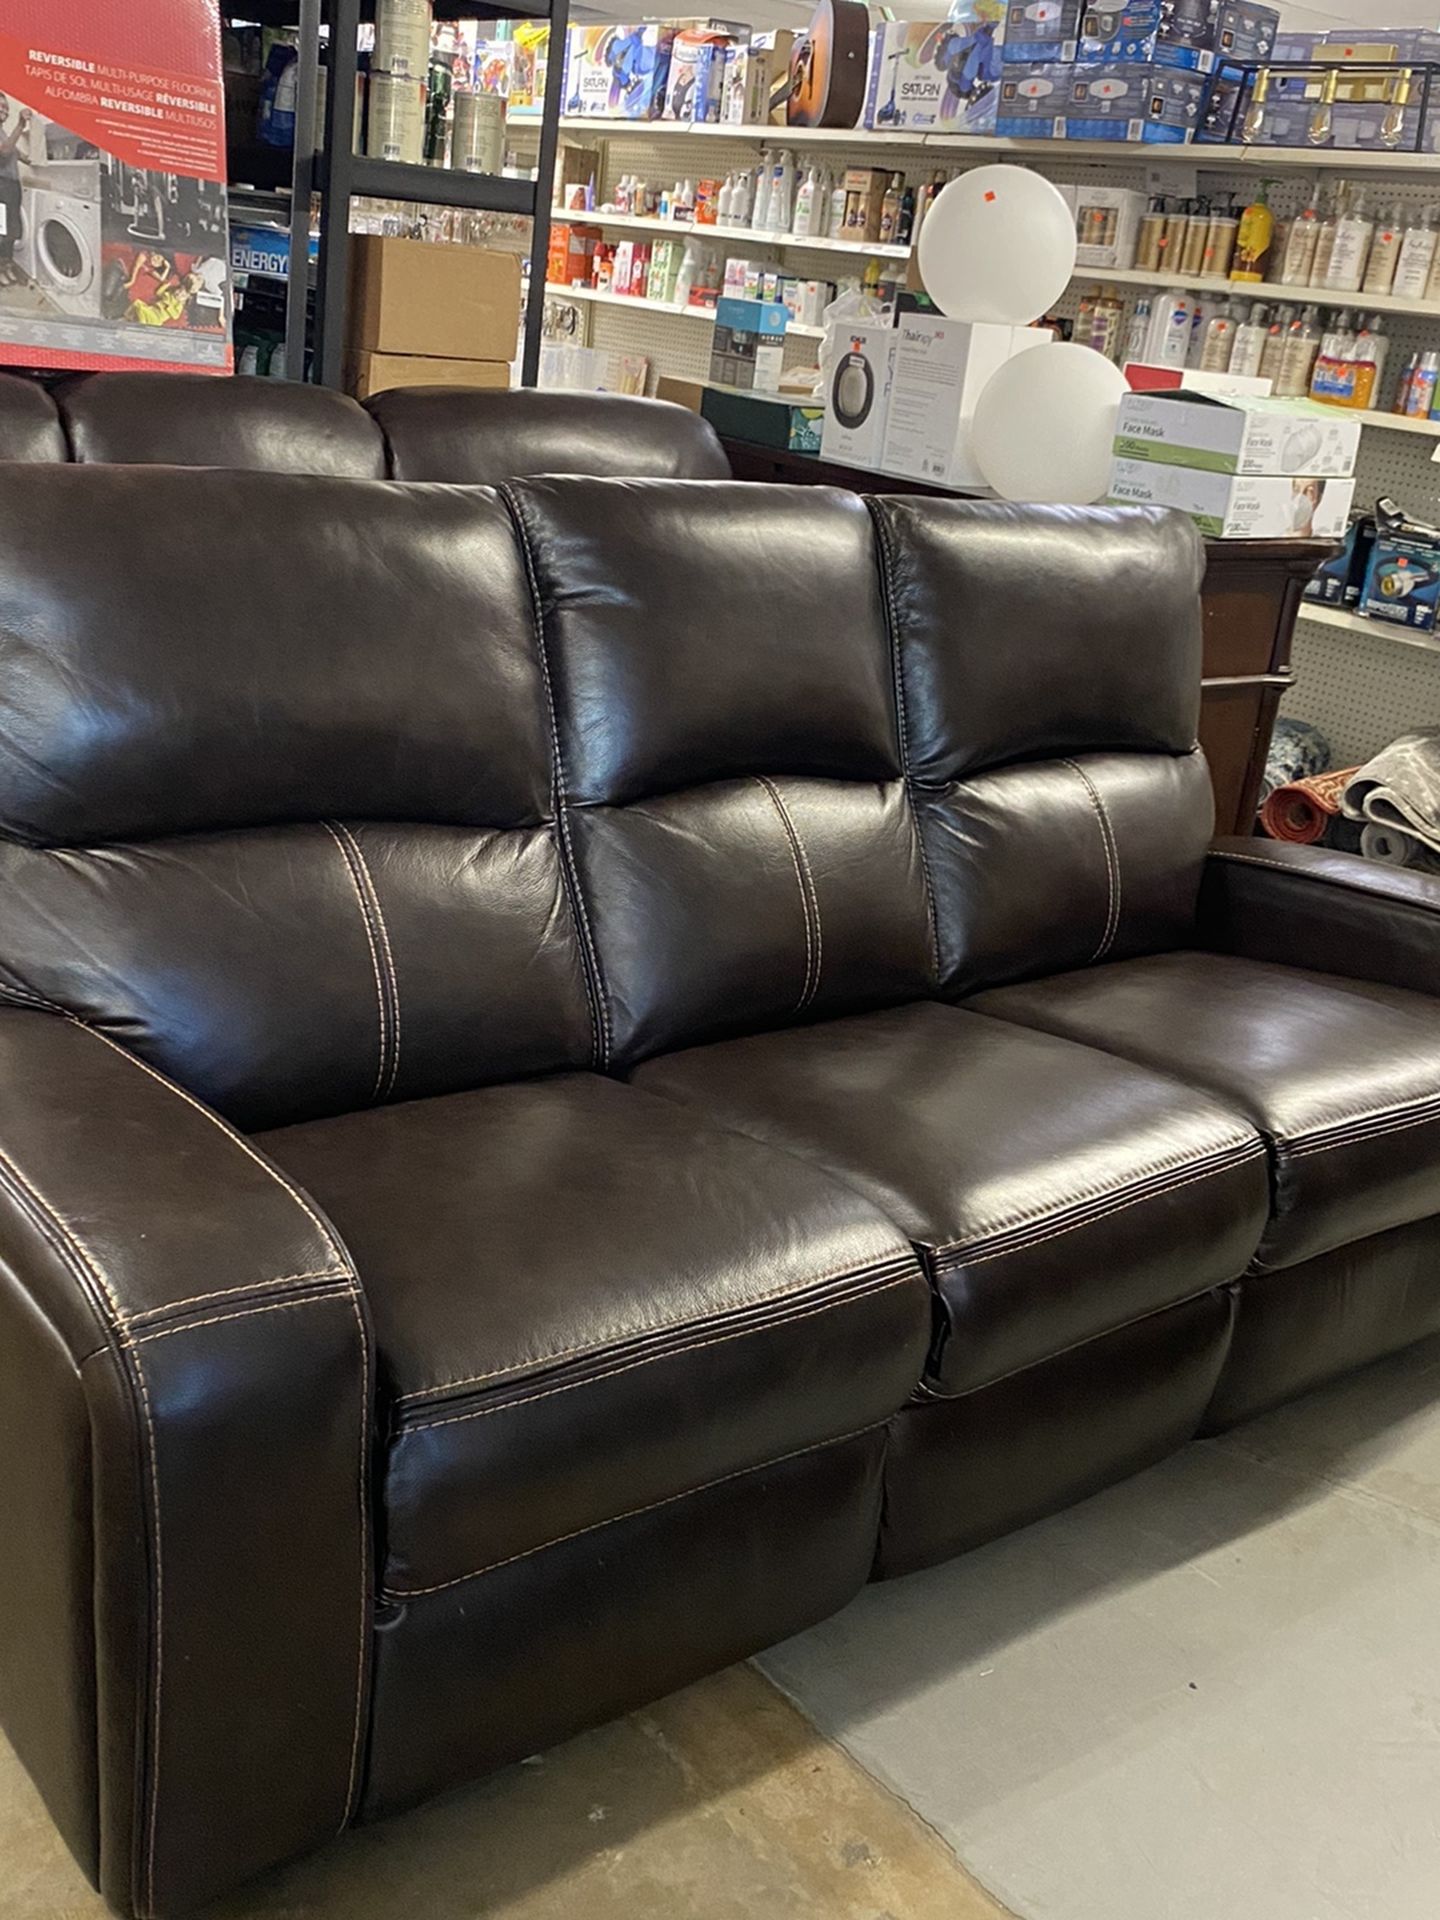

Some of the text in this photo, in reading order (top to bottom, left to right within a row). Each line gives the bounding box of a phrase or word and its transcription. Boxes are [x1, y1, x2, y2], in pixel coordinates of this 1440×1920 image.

[28, 49, 217, 100] REVERSIBLE MULTI-PURPOSE FLOORING
[24, 64, 217, 115] TAPIS DE SOL MULTI-USAGE RÉVERSIBLE
[901, 82, 940, 96] SATURN
[44, 85, 217, 130] ALFOMBRA REVERSIBLE MULTIUSOS
[232, 249, 288, 273] ENERGY
[1122, 421, 1165, 438] Face Mask
[1113, 484, 1153, 500] Face Mask
